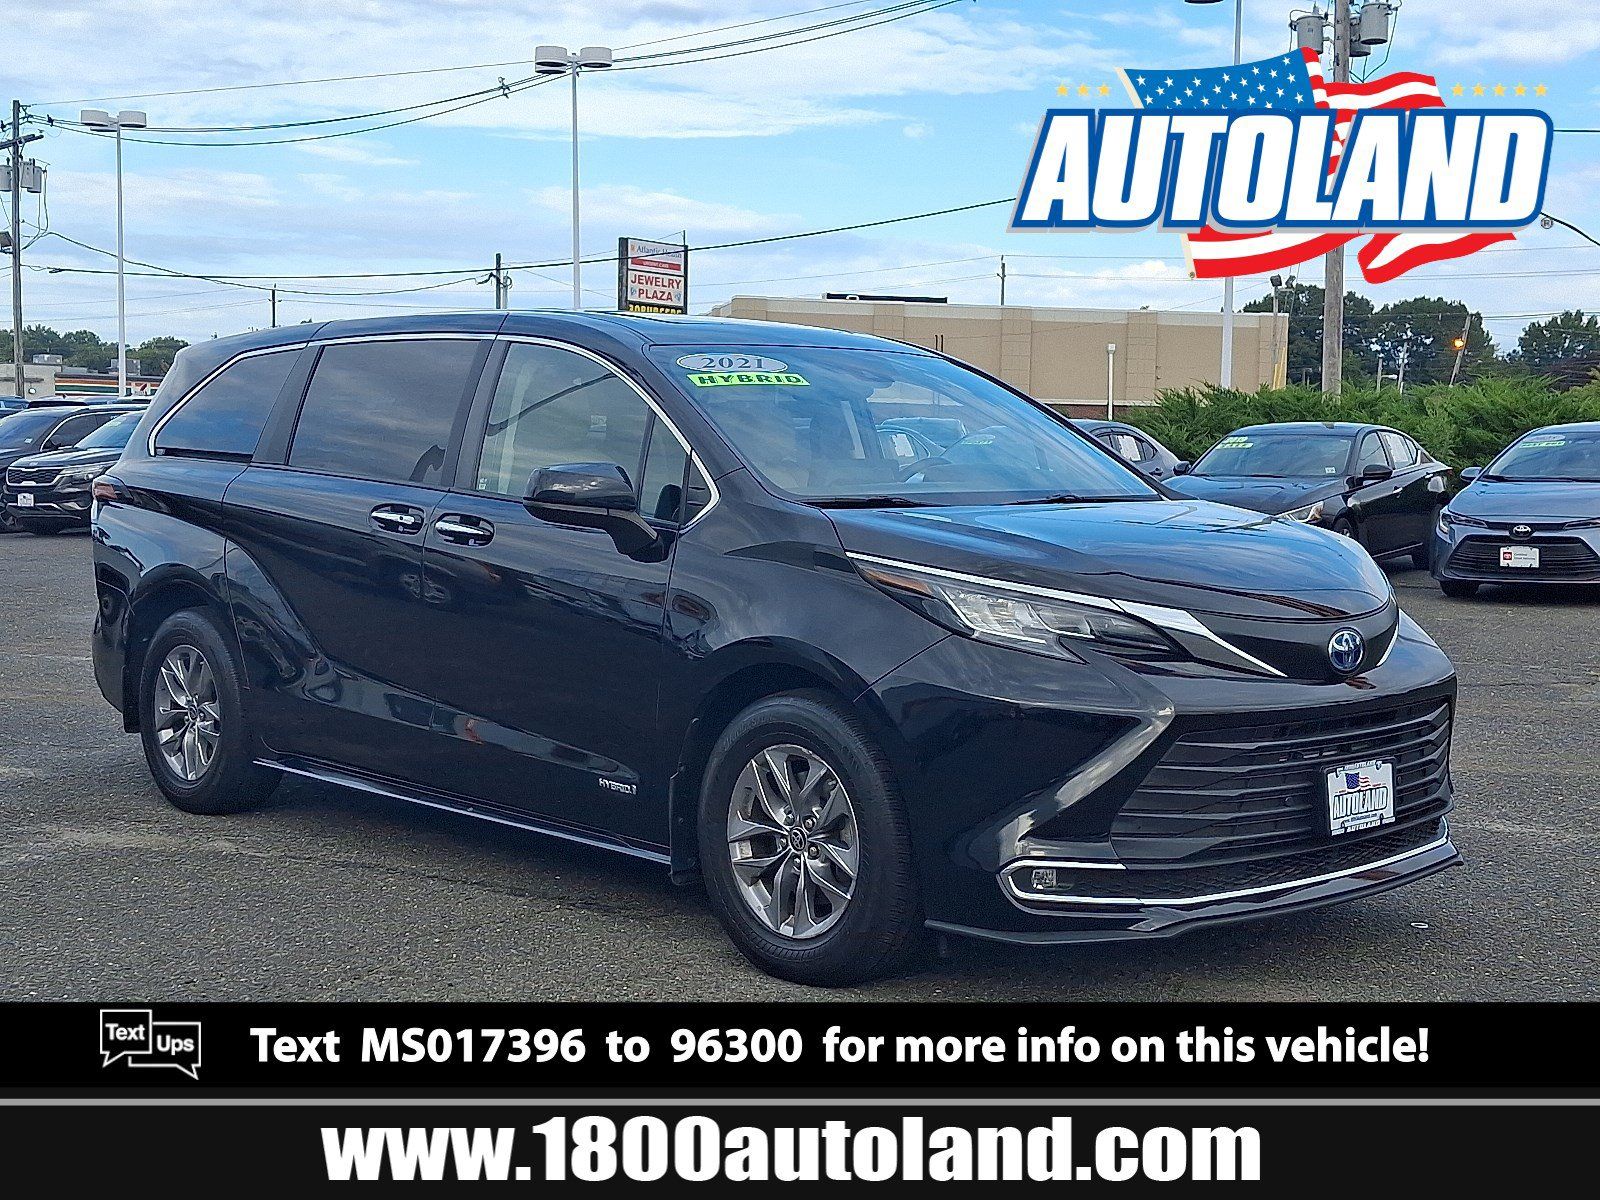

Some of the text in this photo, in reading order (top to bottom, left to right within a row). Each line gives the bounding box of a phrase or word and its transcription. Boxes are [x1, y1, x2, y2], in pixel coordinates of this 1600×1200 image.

[636, 245, 682, 259] Atlantic Halth
[631, 274, 682, 290] JEWELRY
[638, 289, 673, 302] PLAZA
[701, 357, 767, 369] 2021
[697, 374, 804, 385] HYBRID
[598, 778, 631, 794] HYBRID
[1333, 787, 1388, 820] AUTOLAND
